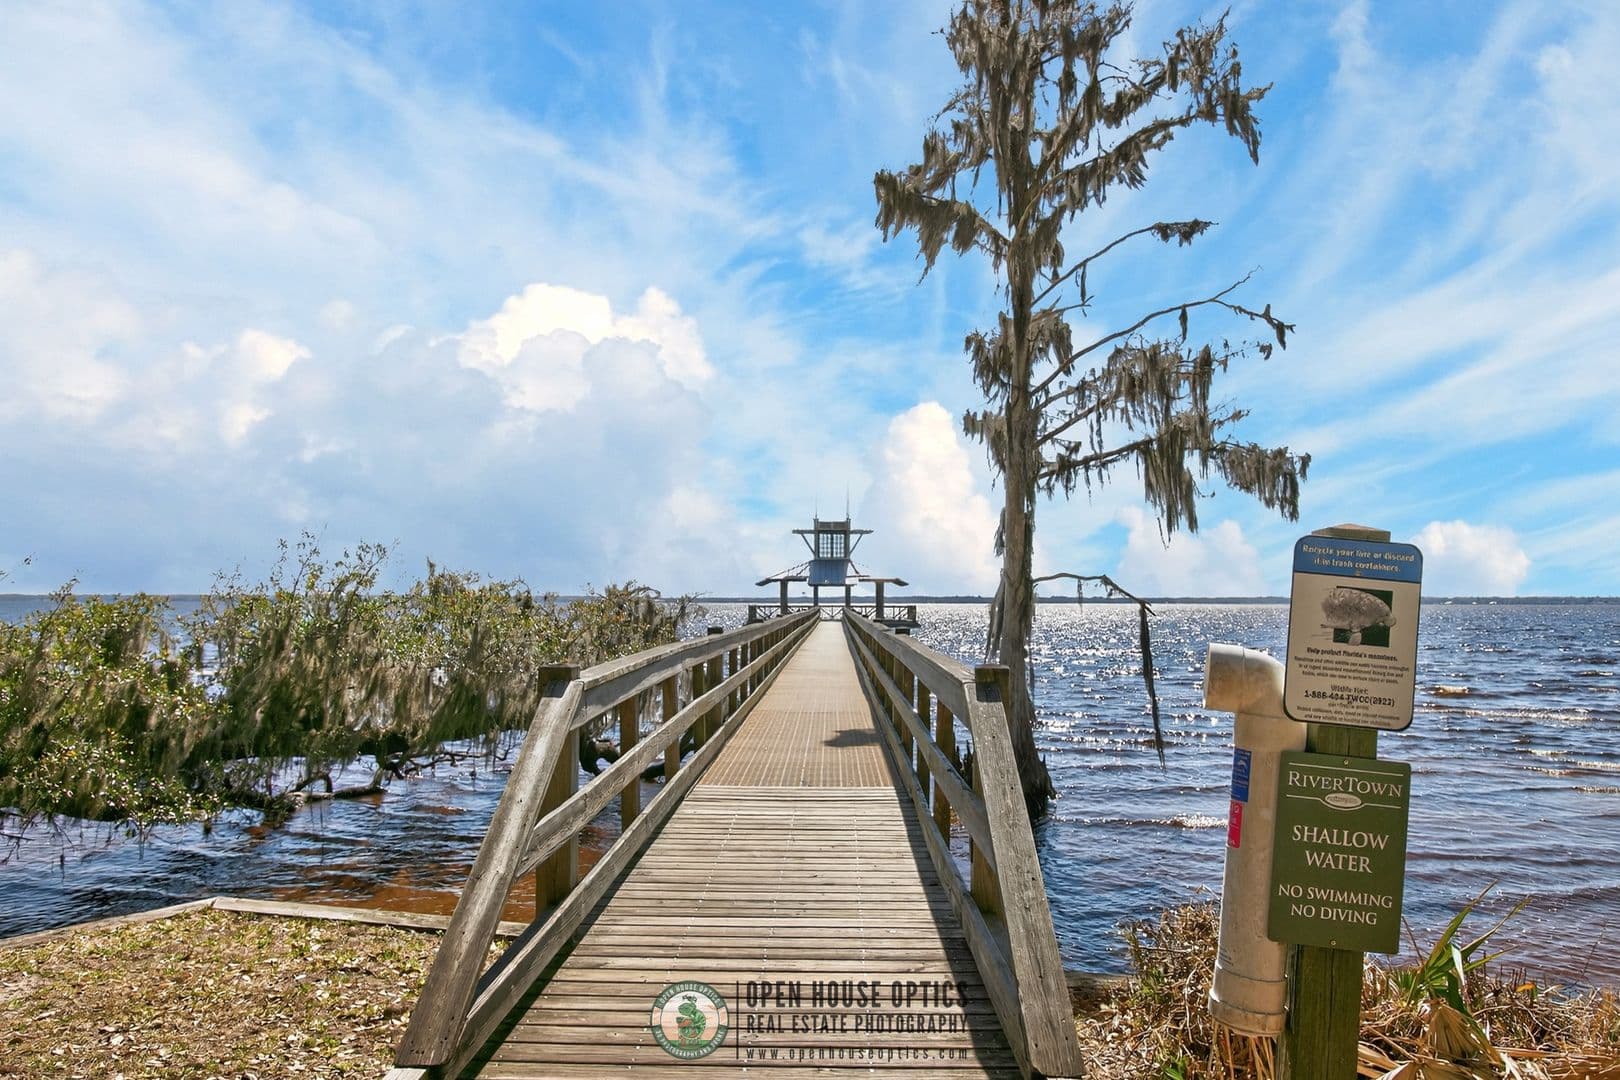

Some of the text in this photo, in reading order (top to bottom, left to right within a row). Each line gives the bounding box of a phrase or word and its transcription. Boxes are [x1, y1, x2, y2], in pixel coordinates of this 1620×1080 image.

[1331, 559, 1353, 568] trash
[1336, 548, 1354, 557] your
[1383, 553, 1415, 562] discard
[1321, 649, 1341, 657] protect
[1292, 825, 1389, 850] SHALLOW
[1305, 850, 1373, 874] WATER
[1278, 884, 1393, 908] NO SWIMMING
[1291, 904, 1378, 925] NO DIVING
